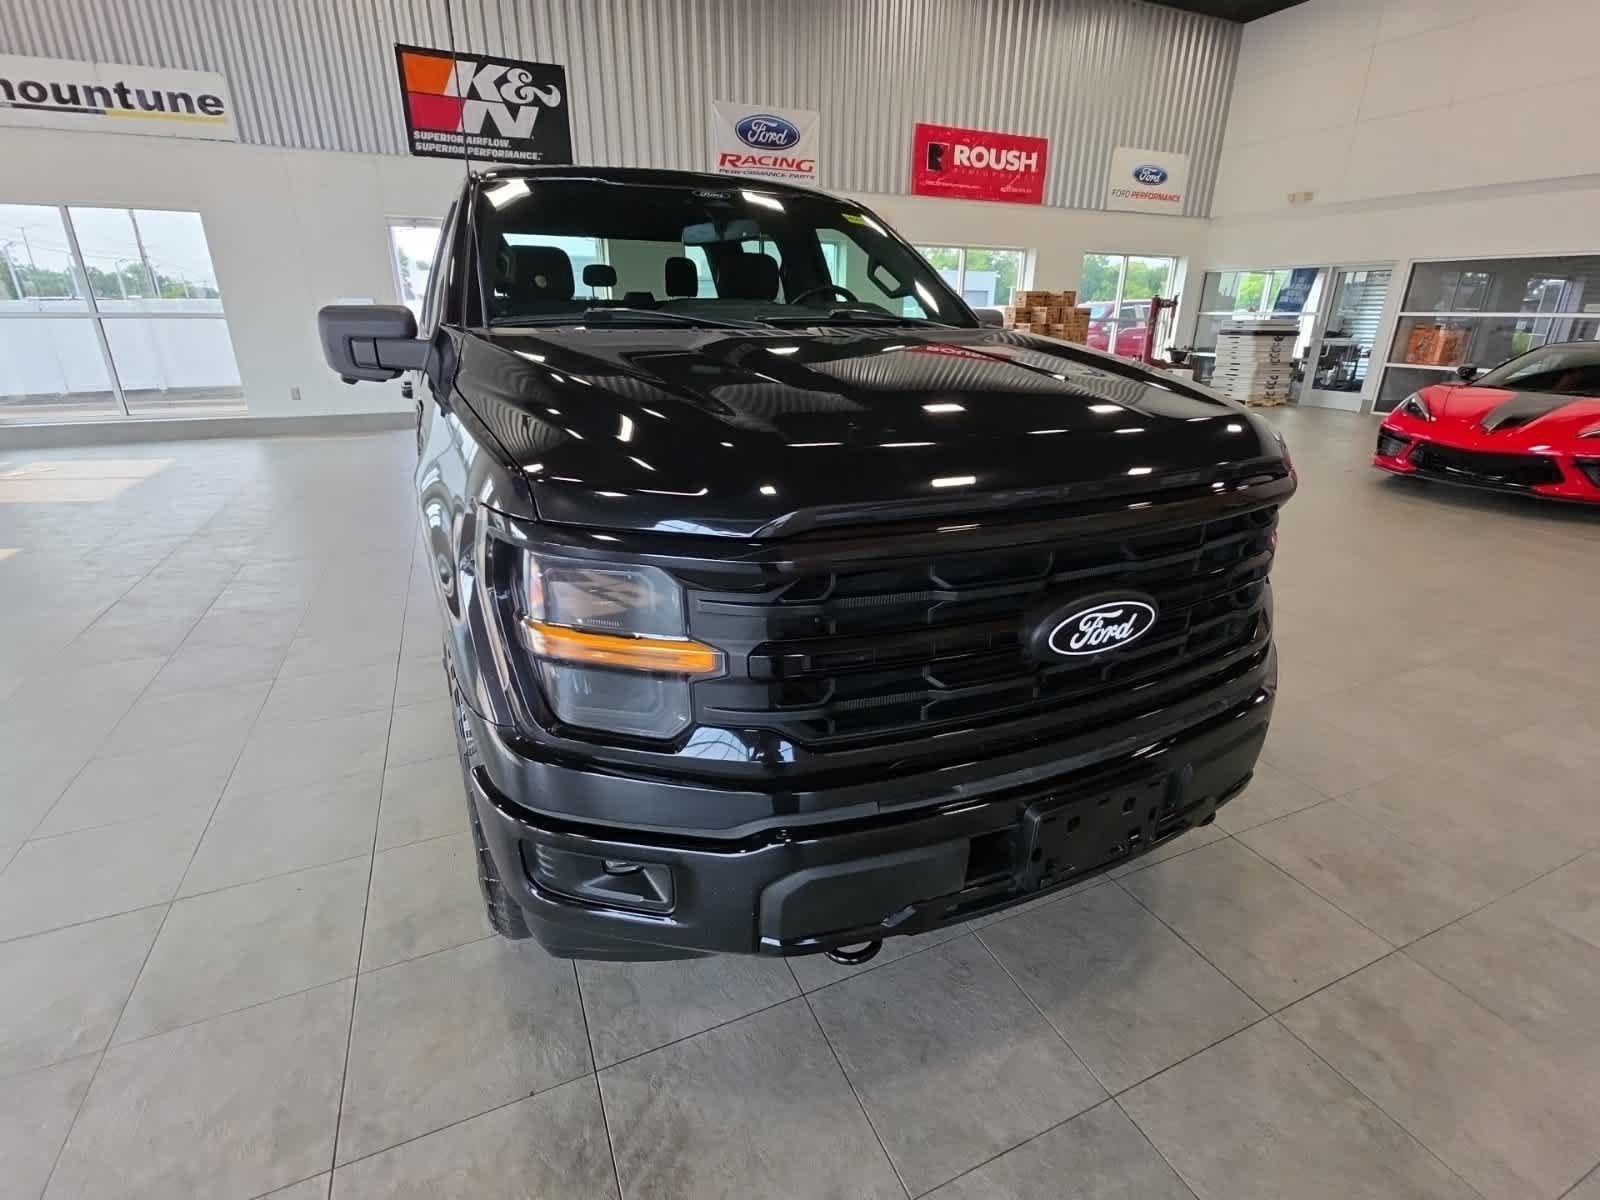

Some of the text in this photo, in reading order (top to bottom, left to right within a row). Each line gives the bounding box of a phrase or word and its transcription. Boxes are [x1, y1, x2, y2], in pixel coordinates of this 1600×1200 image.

[413, 131, 511, 148] SUPERIOR AIRFLOW.
[747, 119, 788, 145] Ford
[415, 142, 465, 154] SUPERIOR
[719, 152, 816, 173] RACING
[953, 144, 1038, 172] ROUSH
[1139, 167, 1162, 183] Ford
[1112, 189, 1130, 198] FORD
[1070, 609, 1137, 649] Ford
